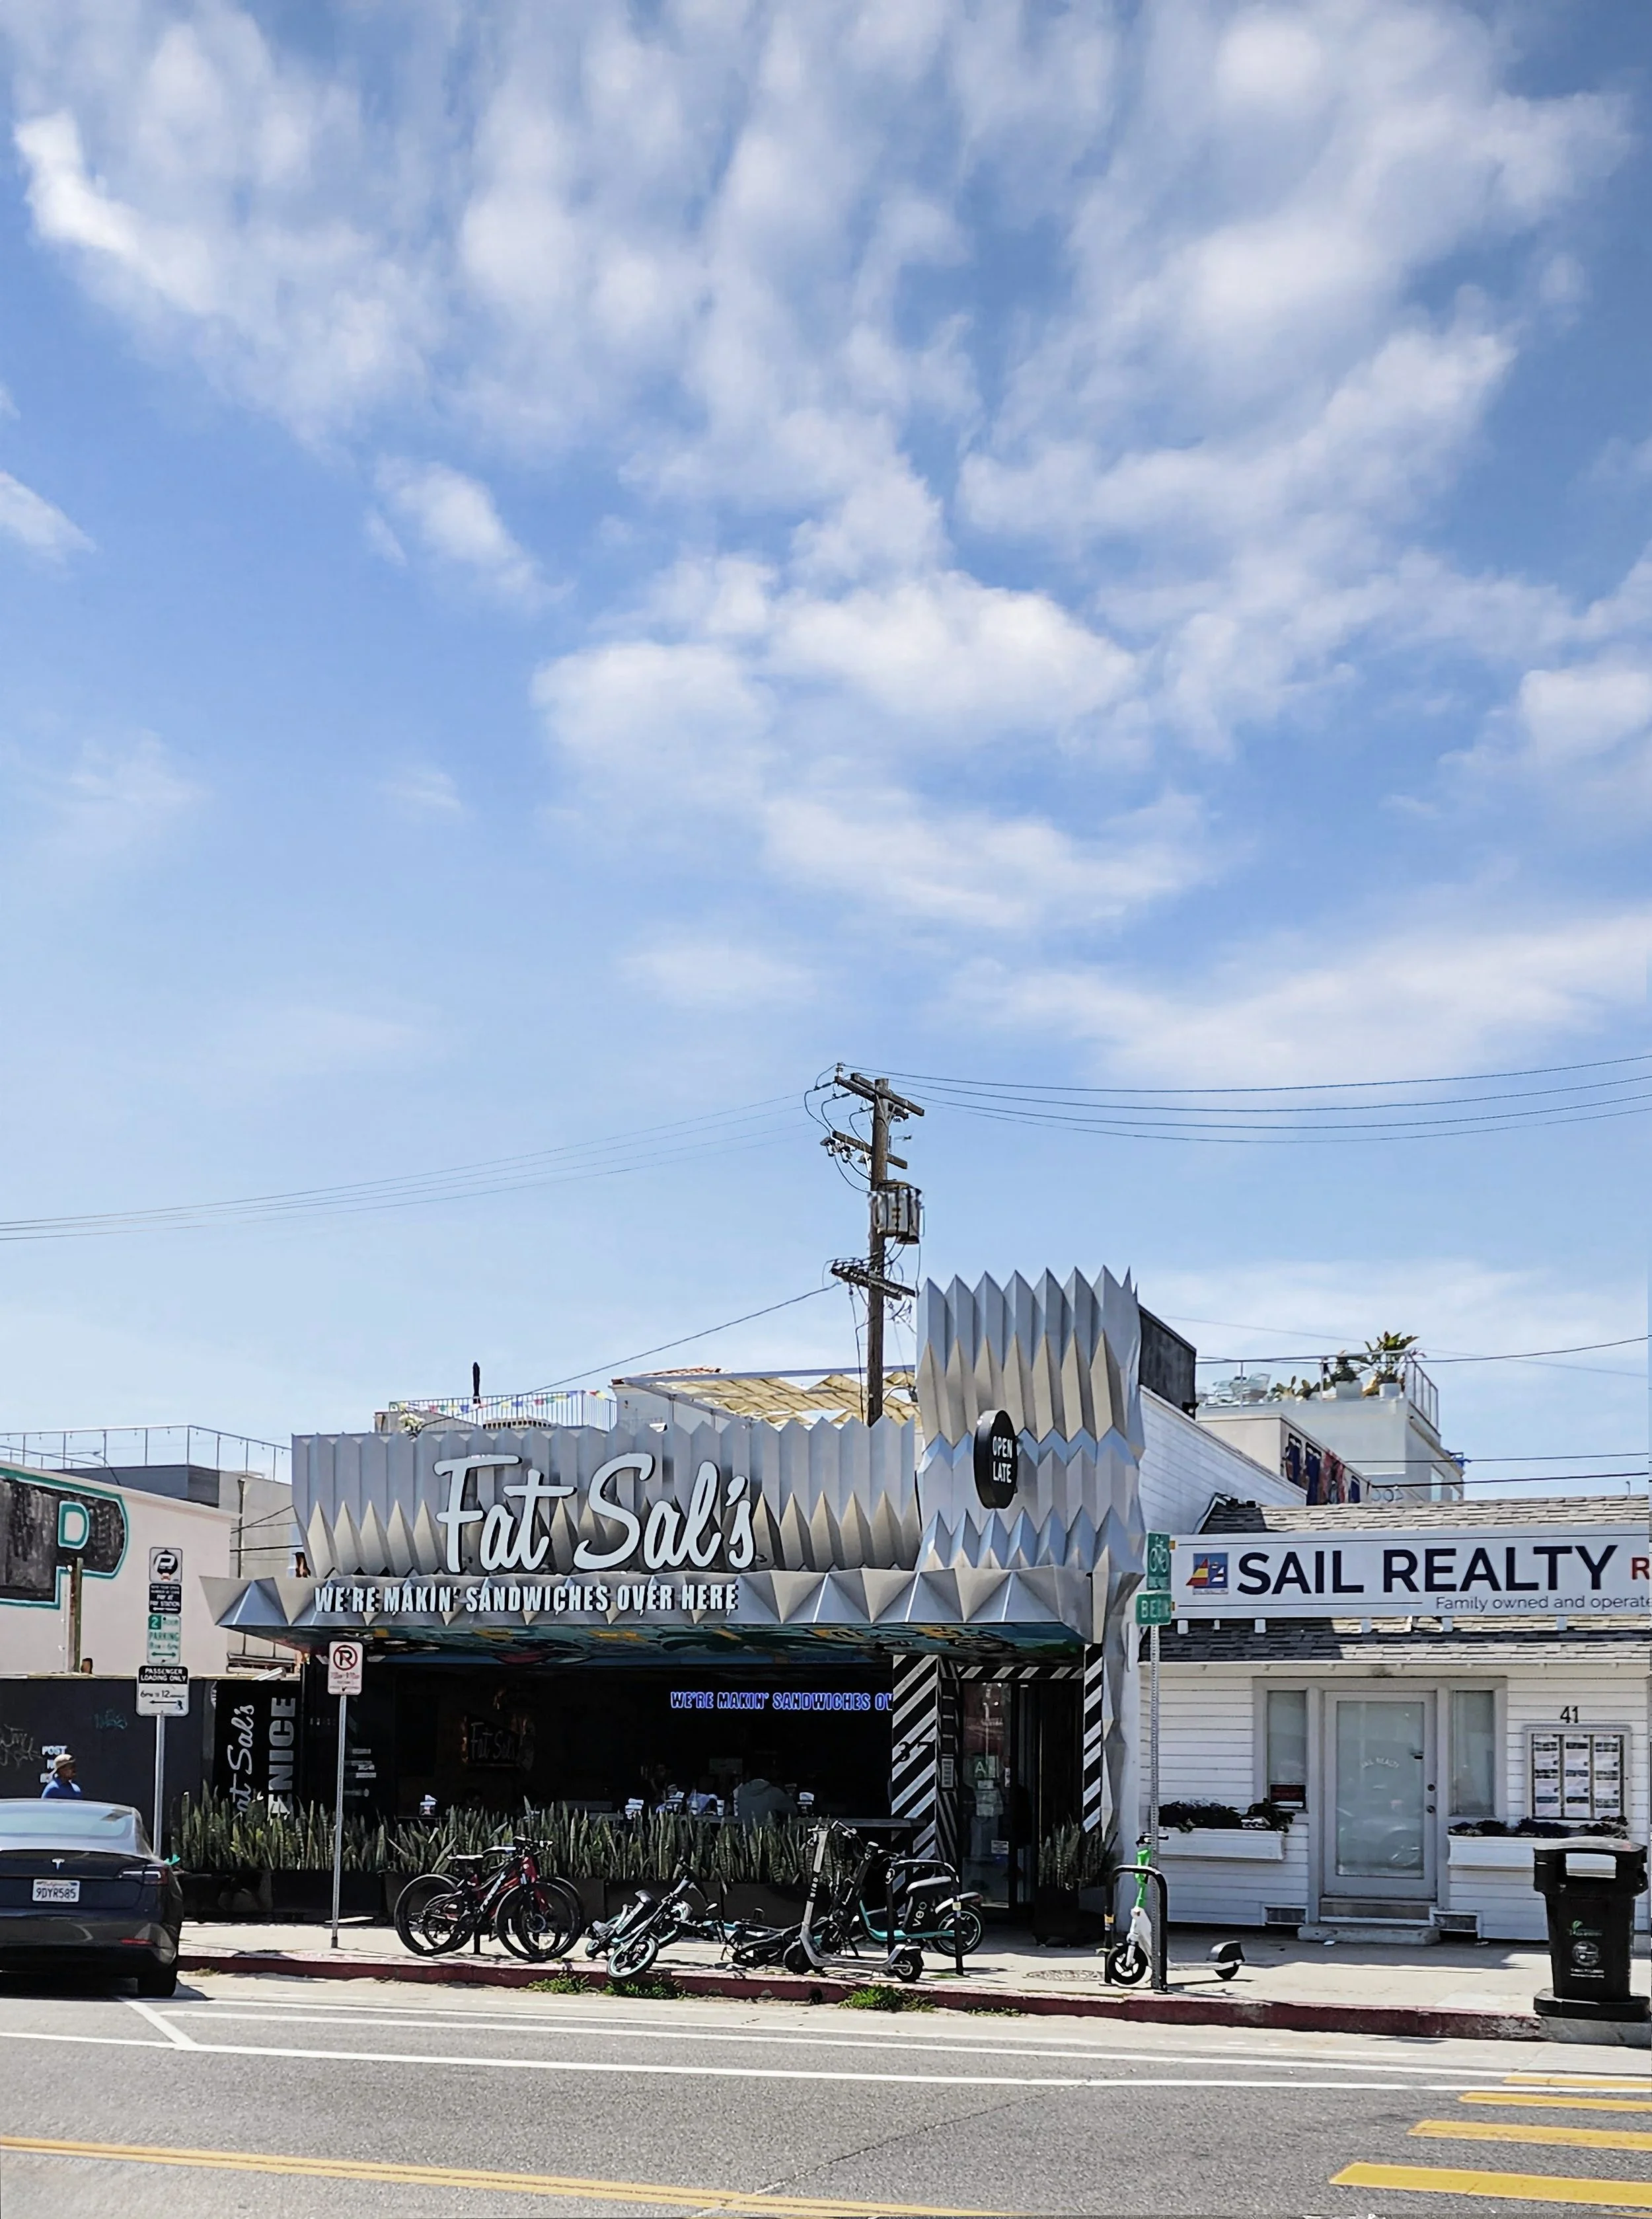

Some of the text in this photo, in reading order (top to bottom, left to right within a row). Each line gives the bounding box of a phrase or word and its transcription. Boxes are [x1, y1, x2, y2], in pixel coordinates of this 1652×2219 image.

[993, 1436, 1012, 1458] OPEN
[993, 1461, 1012, 1484] LATE
[433, 1453, 755, 1573] Fat Sal's
[1237, 1550, 1364, 1595] SAIL
[1383, 1544, 1618, 1593] REALTY
[315, 1584, 737, 1612] WE'RE MAKIN' SANDWICHES OVER HERE
[1436, 1596, 1488, 1612] Family
[1492, 1595, 1549, 1610] owned
[1554, 1595, 1585, 1608] and
[151, 1616, 159, 1628] 2
[670, 1692, 893, 1711] WE'RE MAKIN' SANDWICHES OV
[1560, 1706, 1579, 1723] 41
[42, 1745, 67, 1756] POST
[227, 1704, 254, 1813] at Sal's
[267, 1697, 296, 1822] ENICE
